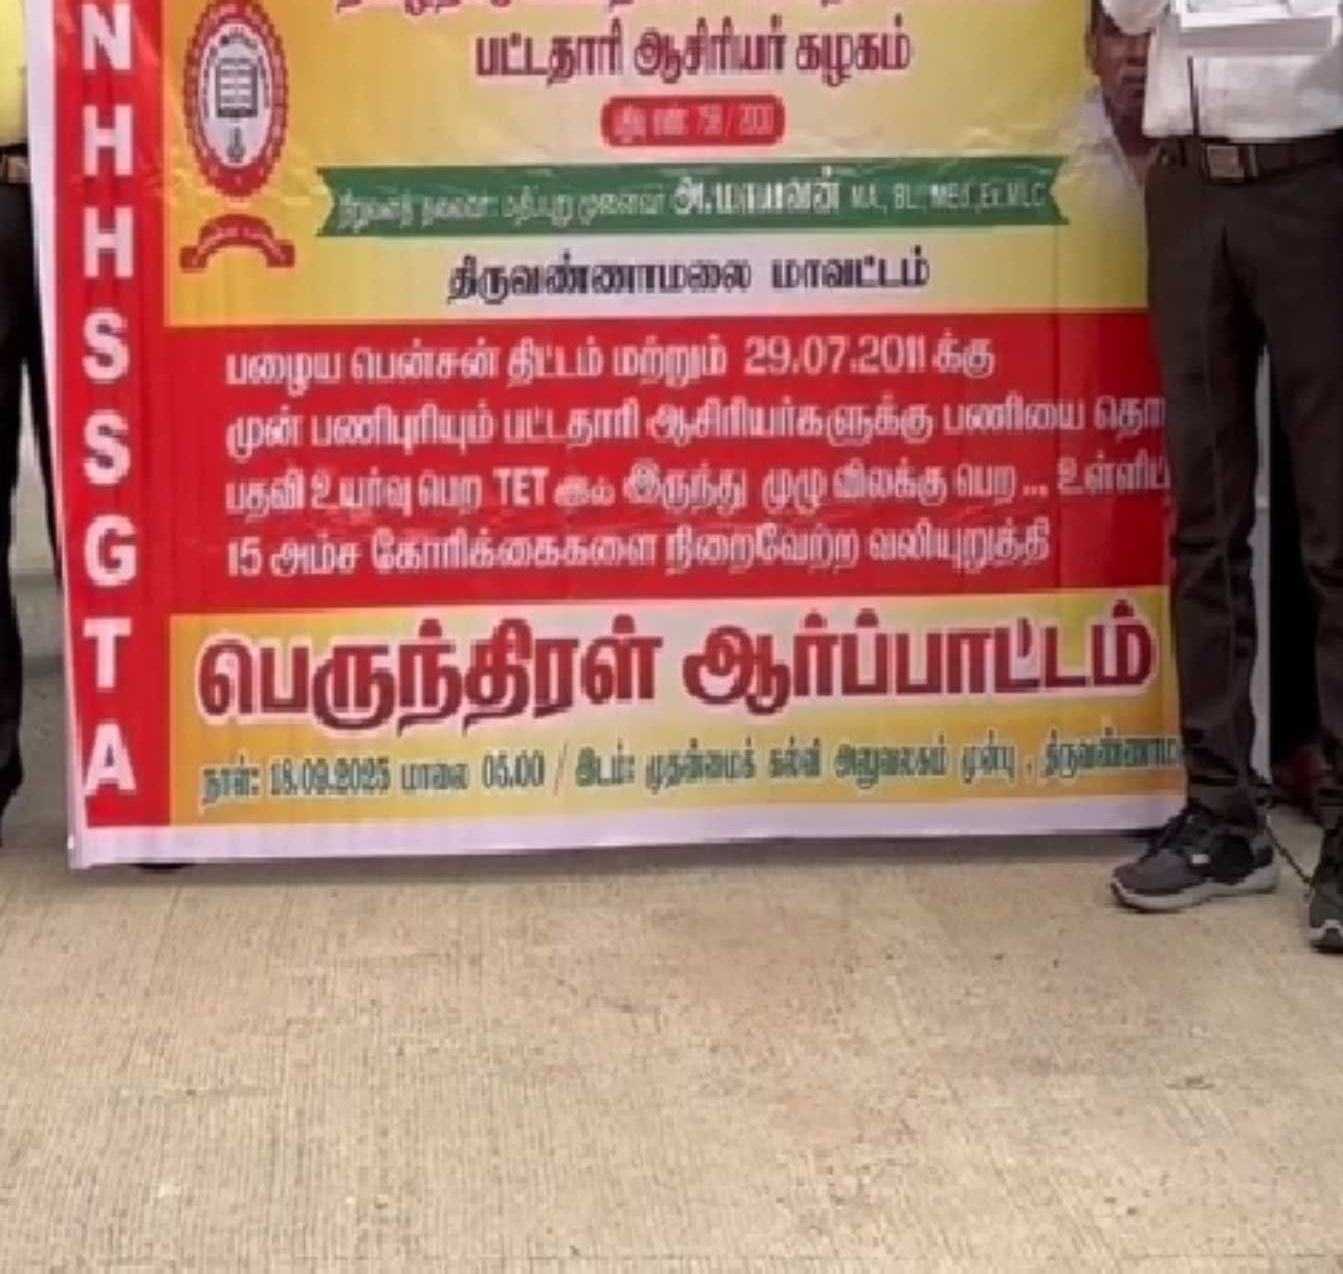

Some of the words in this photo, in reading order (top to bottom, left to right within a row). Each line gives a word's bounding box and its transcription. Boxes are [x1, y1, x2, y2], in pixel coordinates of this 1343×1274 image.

[475, 18, 622, 87] பட்டதாரி
[634, 14, 788, 84] ஆசிரியர்
[795, 14, 913, 86] கழகம்
[447, 248, 752, 304] திருவண்ணாமலை
[771, 244, 930, 289] மாவட்டம்
[225, 348, 341, 397] பழைய
[351, 338, 500, 384] பென்சன்
[507, 335, 604, 388] திட்டம்
[613, 334, 728, 388] மற்றும்
[225, 404, 303, 462] முன்
[310, 398, 494, 455] பணிபுரியும்
[504, 397, 640, 449] பட்டதாரி
[645, 389, 934, 447] ஆசிரியர்களுக்கு
[943, 389, 1085, 436] பணியை
[225, 466, 304, 522] பதவி
[311, 466, 412, 517] உயர்வு
[418, 468, 483, 520] பெற
[492, 466, 549, 507] TET
[622, 457, 747, 516] இருந்து
[762, 468, 827, 516] முழு
[832, 456, 947, 507] விலக்கு
[955, 463, 1016, 506] பெற
[1056, 450, 1171, 496] உள்ளிட்
[227, 536, 263, 577] 15
[270, 531, 362, 578] அம்ச
[370, 526, 657, 572] கோரிக்கைகளை
[665, 522, 860, 576] நிறைவேற்ற
[869, 515, 1051, 575] வலியுறுத்தி
[197, 613, 664, 737] பெருந்திரள்
[681, 599, 1154, 716] ஆர்ப்பாட்டம்
[400, 761, 470, 791] மாலை
[482, 749, 545, 789] 05.00
[833, 730, 949, 788] அலுவலகம்
